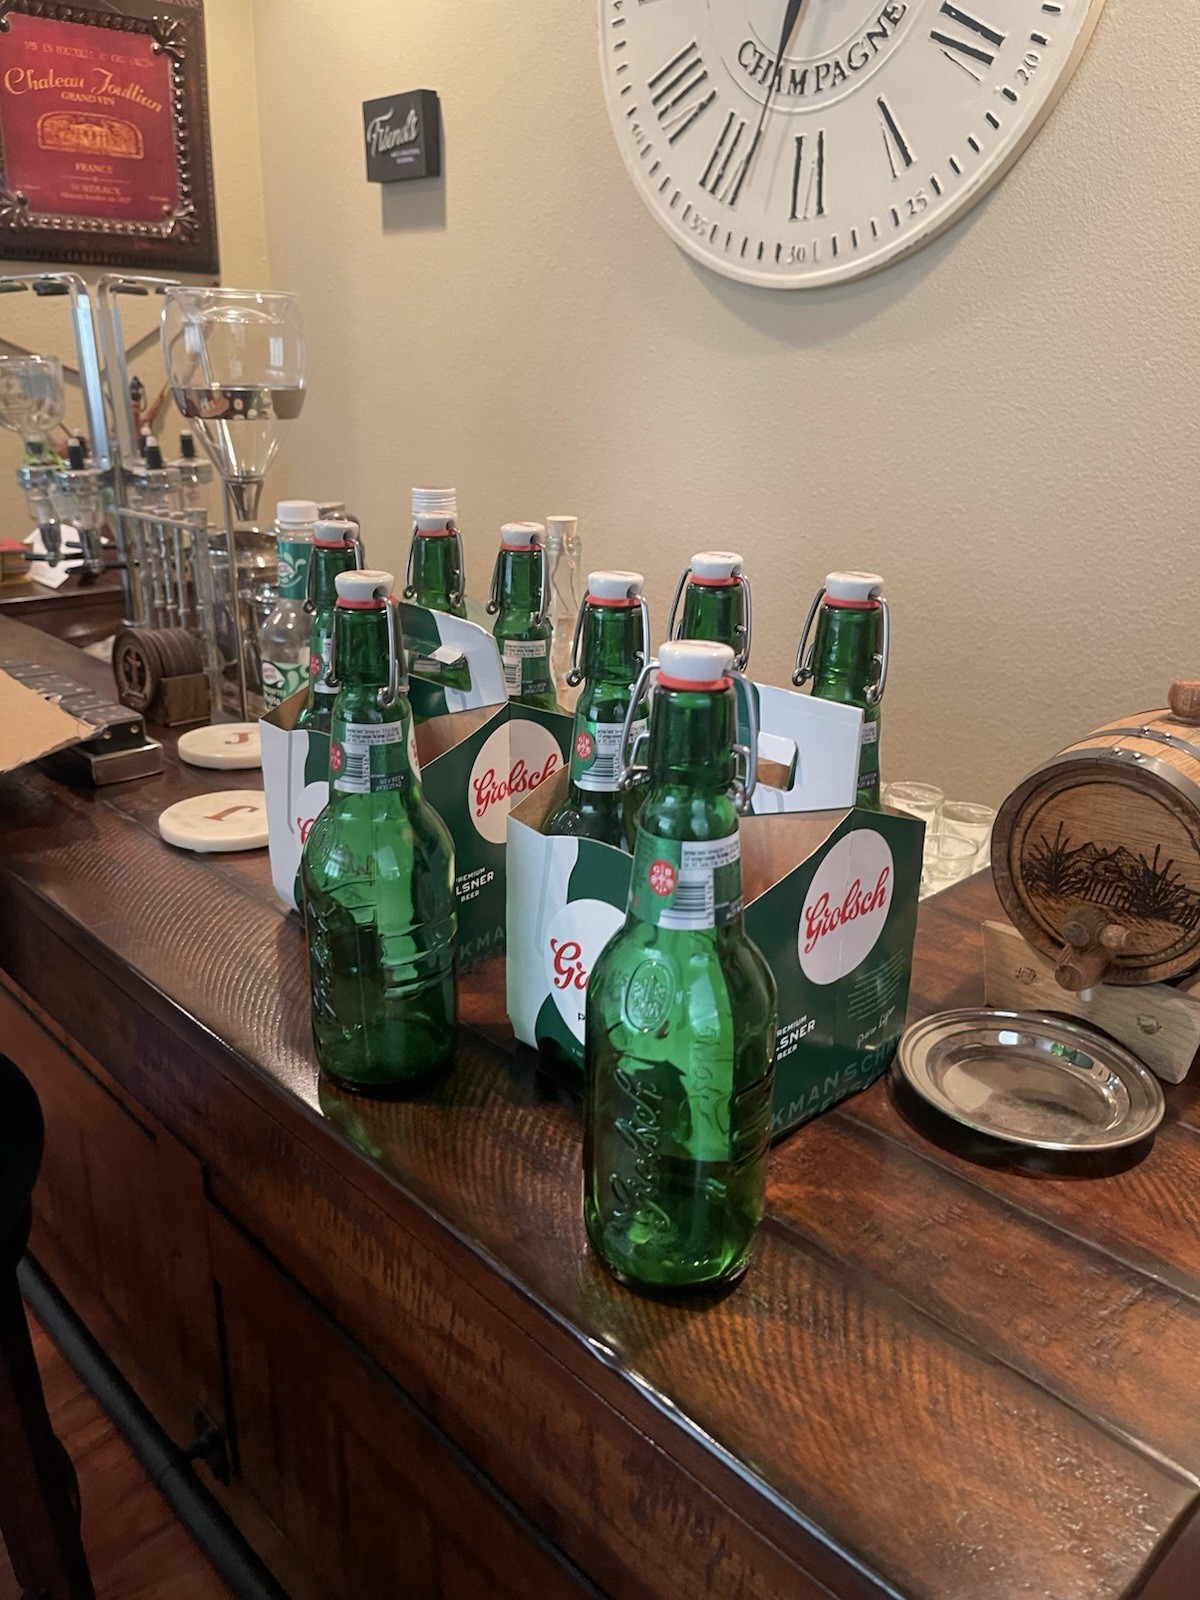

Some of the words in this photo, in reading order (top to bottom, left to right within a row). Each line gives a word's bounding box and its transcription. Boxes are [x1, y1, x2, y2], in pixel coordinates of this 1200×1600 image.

[738, 0, 907, 96] CHAMPAGNE
[473, 753, 558, 818] Grolsch
[456, 871, 495, 896] LSNER
[460, 890, 480, 903] BEER
[804, 866, 890, 954] Grolsch
[776, 1015, 808, 1037] REMIUM
[776, 1019, 816, 1052] SNER
[776, 1044, 798, 1061] BEER
[769, 1040, 891, 1129] KMANSCH
